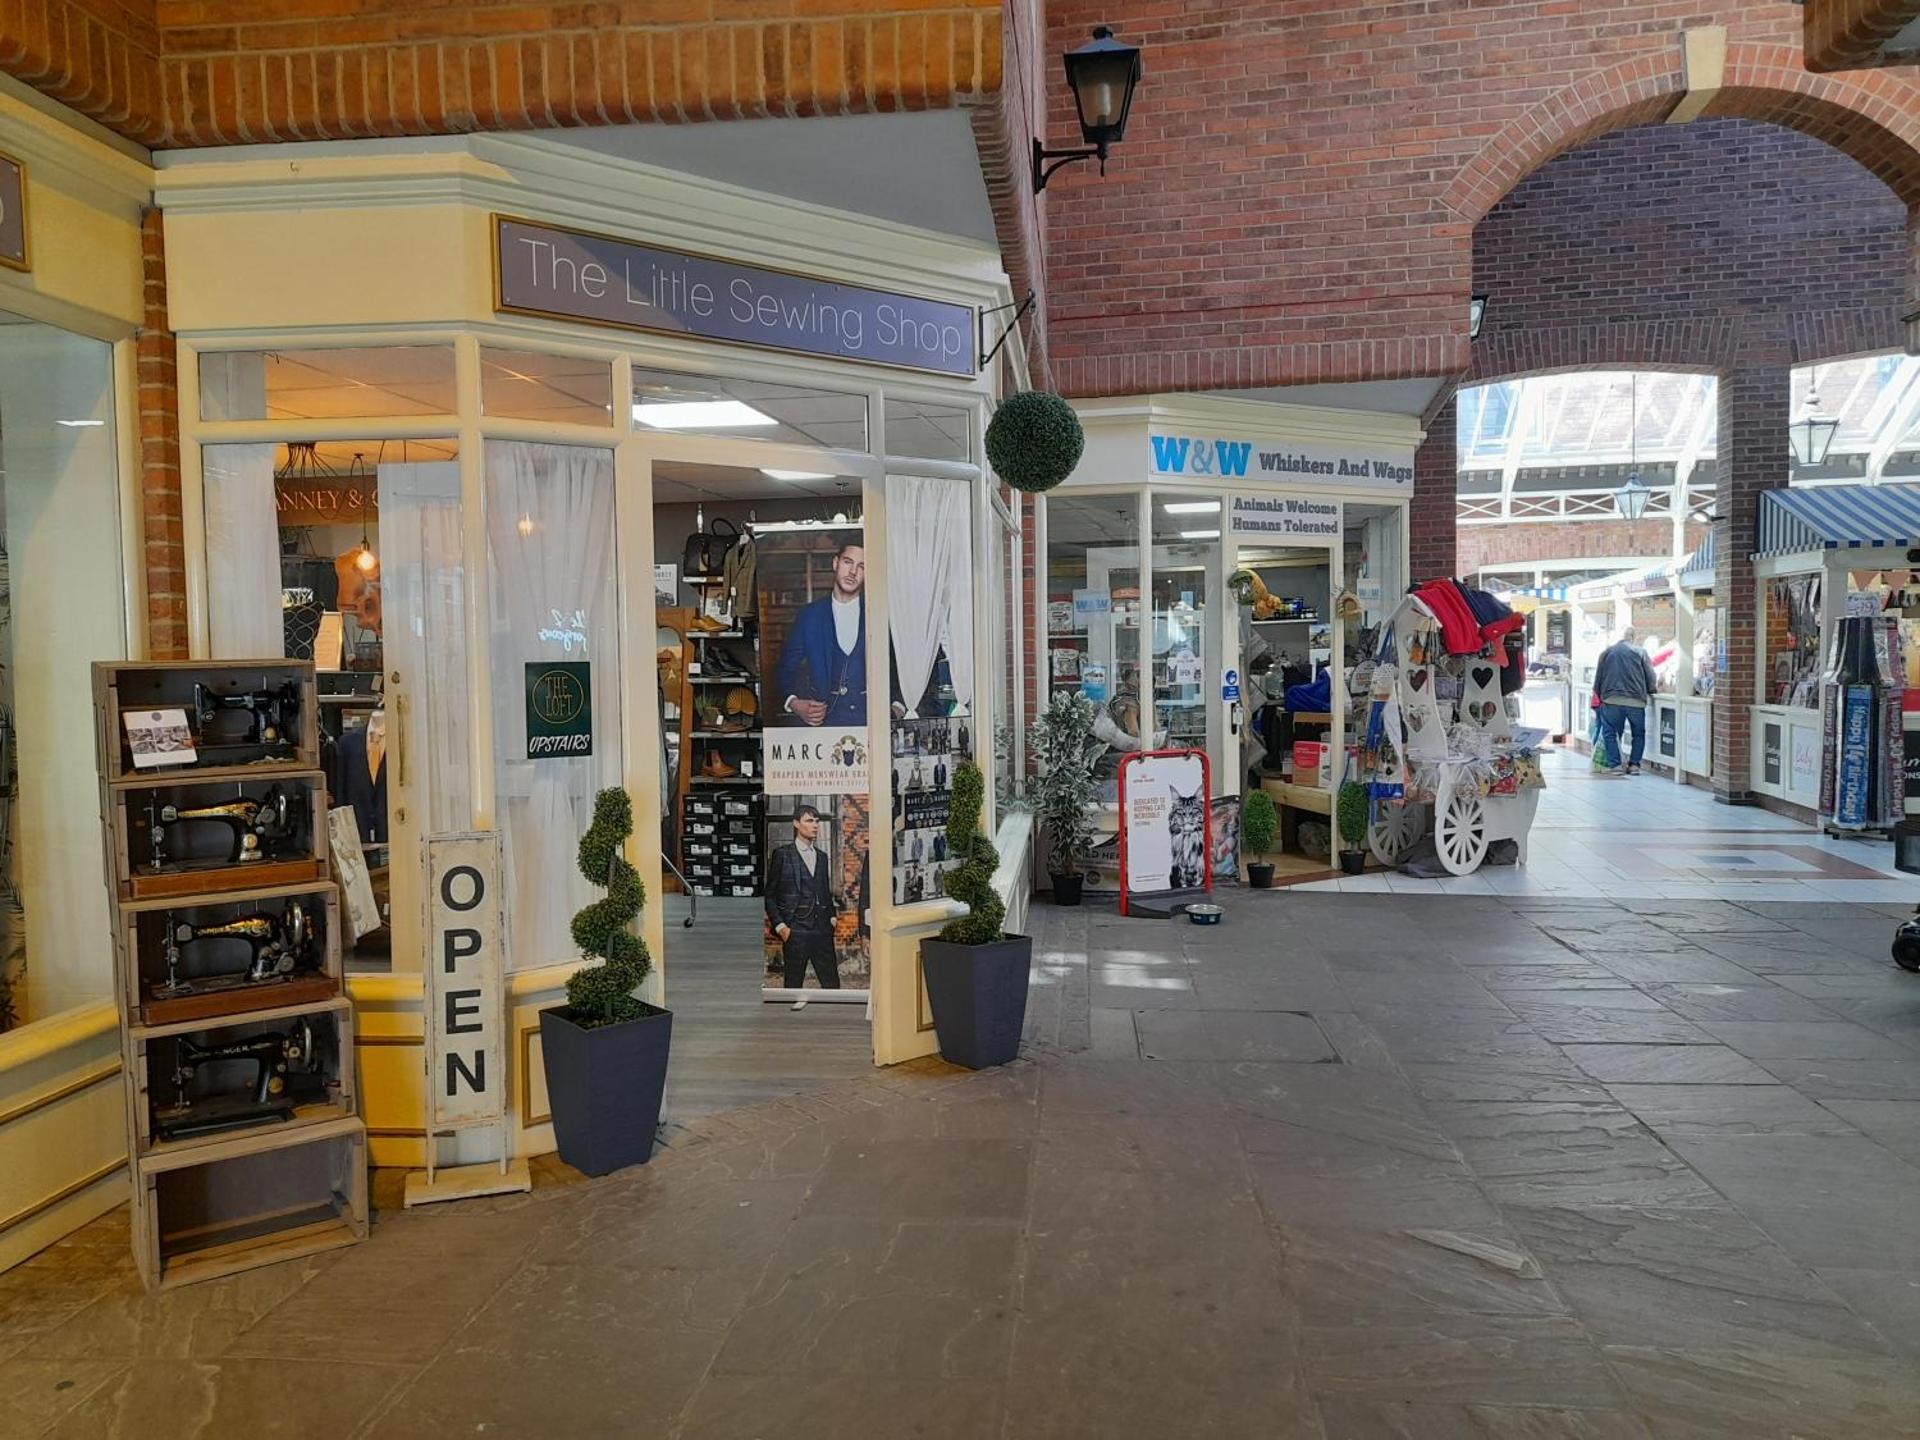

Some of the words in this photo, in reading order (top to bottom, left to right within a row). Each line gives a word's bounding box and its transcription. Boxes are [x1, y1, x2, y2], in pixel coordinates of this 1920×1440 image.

[518, 236, 608, 298] The
[625, 257, 714, 317] Little
[729, 277, 863, 350] Sewing
[876, 303, 962, 362] Shop
[1151, 435, 1253, 478] W&W
[1259, 452, 1335, 477] Whiskers
[1338, 458, 1370, 477] And
[1373, 461, 1413, 483] Wags
[348, 489, 363, 508] &
[1233, 497, 1284, 513] Animals
[1286, 499, 1338, 515] Welcome
[1232, 516, 1282, 532] Humans
[1284, 519, 1338, 534] Tolerated
[545, 676, 569, 697] THE
[545, 695, 573, 717] LOFT
[529, 734, 590, 753] UPSTAIRS
[772, 743, 823, 760] MARC
[440, 864, 486, 1097] OPEN
